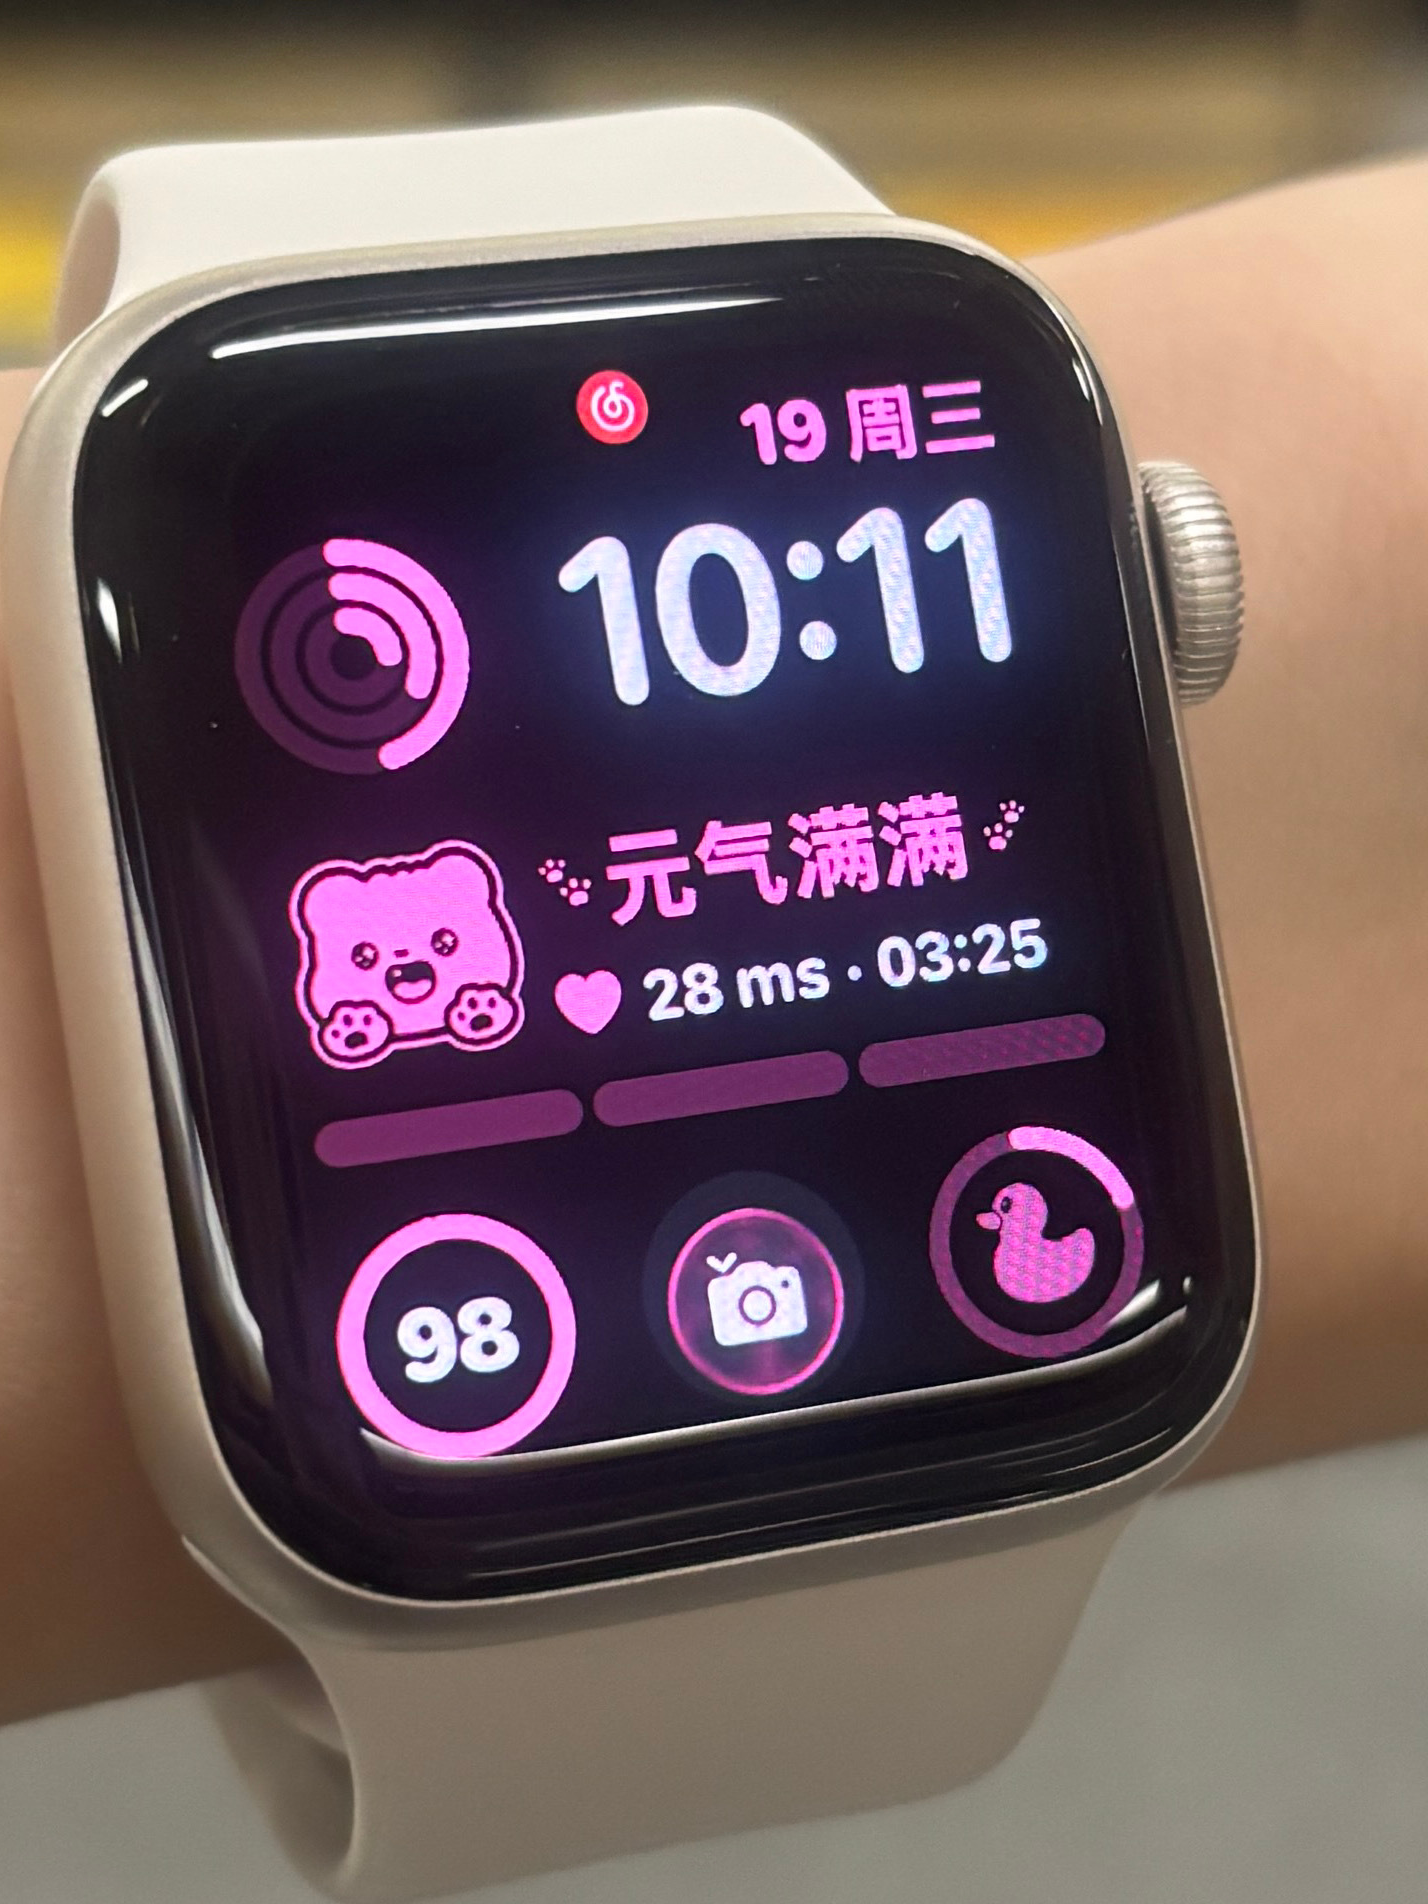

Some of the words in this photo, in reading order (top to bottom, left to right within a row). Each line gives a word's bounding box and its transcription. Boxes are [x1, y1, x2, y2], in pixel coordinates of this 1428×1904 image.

[740, 399, 827, 465] 19
[846, 380, 995, 462] 周三
[558, 498, 1012, 705] 10:11
[606, 792, 968, 926] 元气满满
[643, 963, 724, 1021] 28
[736, 957, 830, 1008] ms
[877, 918, 1048, 987] 03:25
[397, 1297, 520, 1383] 98
